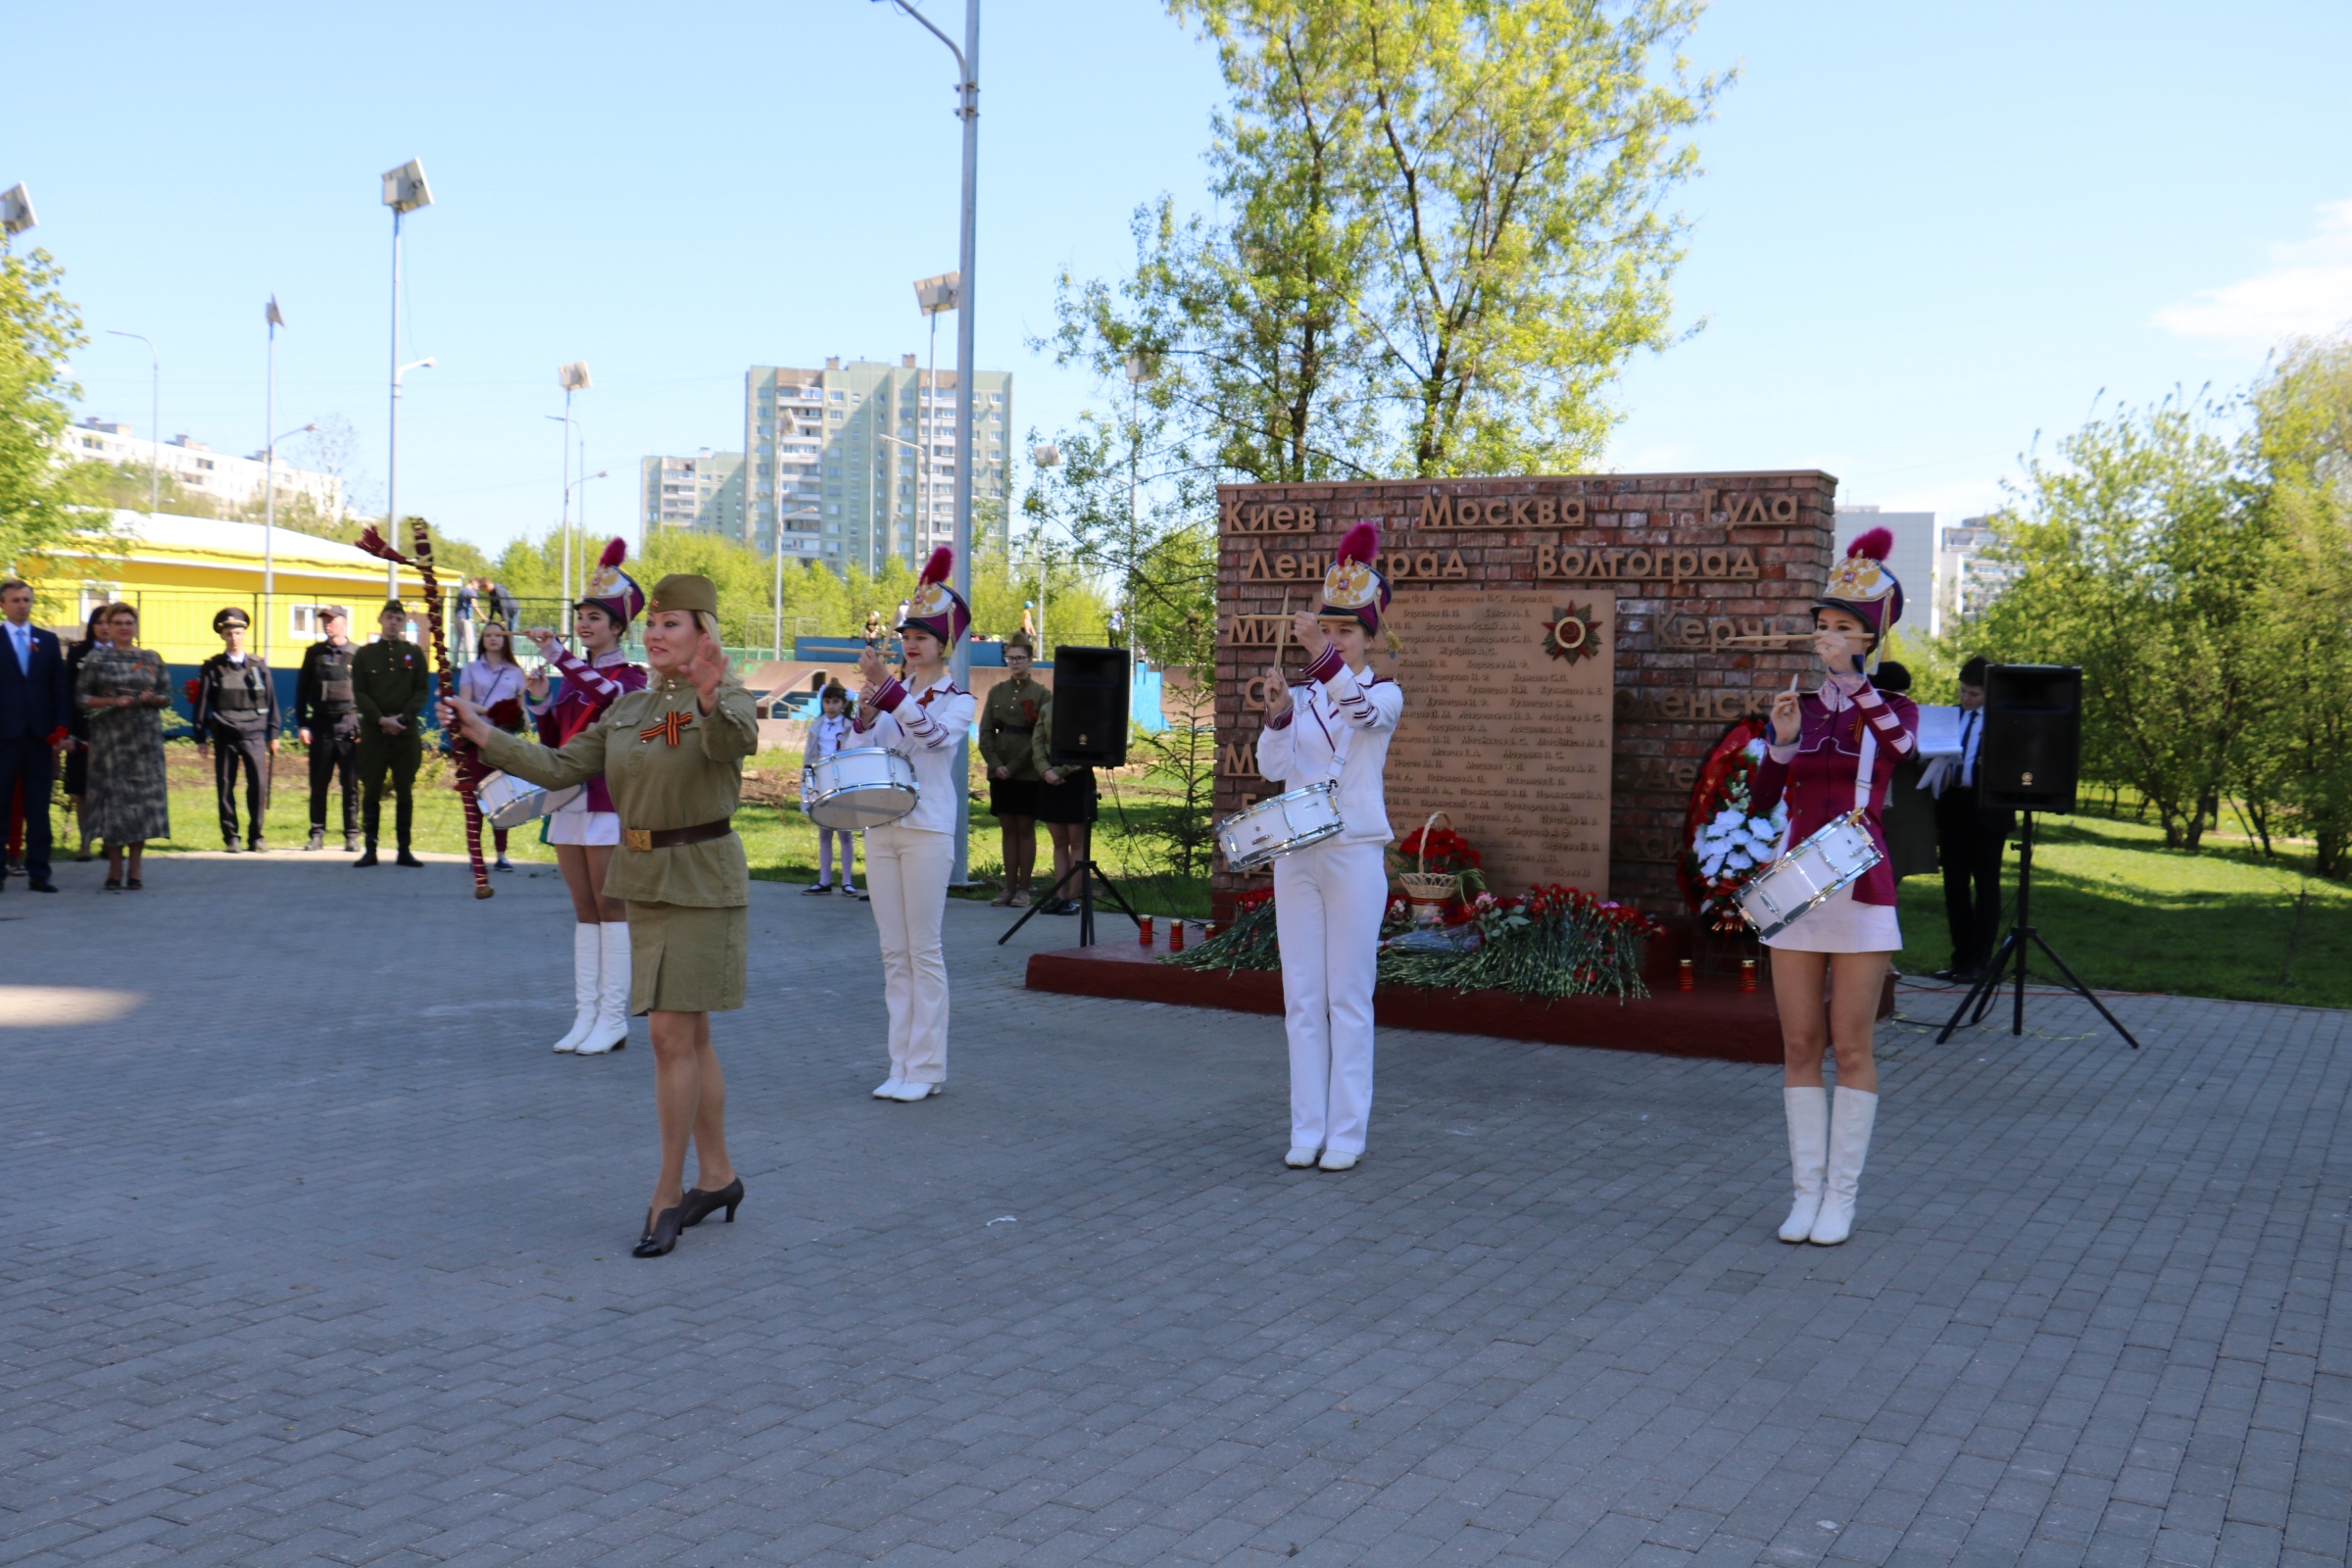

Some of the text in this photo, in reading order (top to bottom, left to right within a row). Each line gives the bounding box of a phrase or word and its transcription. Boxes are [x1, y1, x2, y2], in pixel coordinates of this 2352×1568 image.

[1227, 501, 1316, 531] Киев
[1421, 494, 1586, 526] Москва
[1700, 490, 1797, 530] Тула
[1246, 548, 1468, 584] Ленрад
[1538, 544, 1759, 584] Волгоград
[1403, 610, 1440, 618] Баранов
[1484, 609, 1510, 617] Белов
[1653, 611, 1788, 657] Керчь
[1614, 688, 1768, 718] оленск
